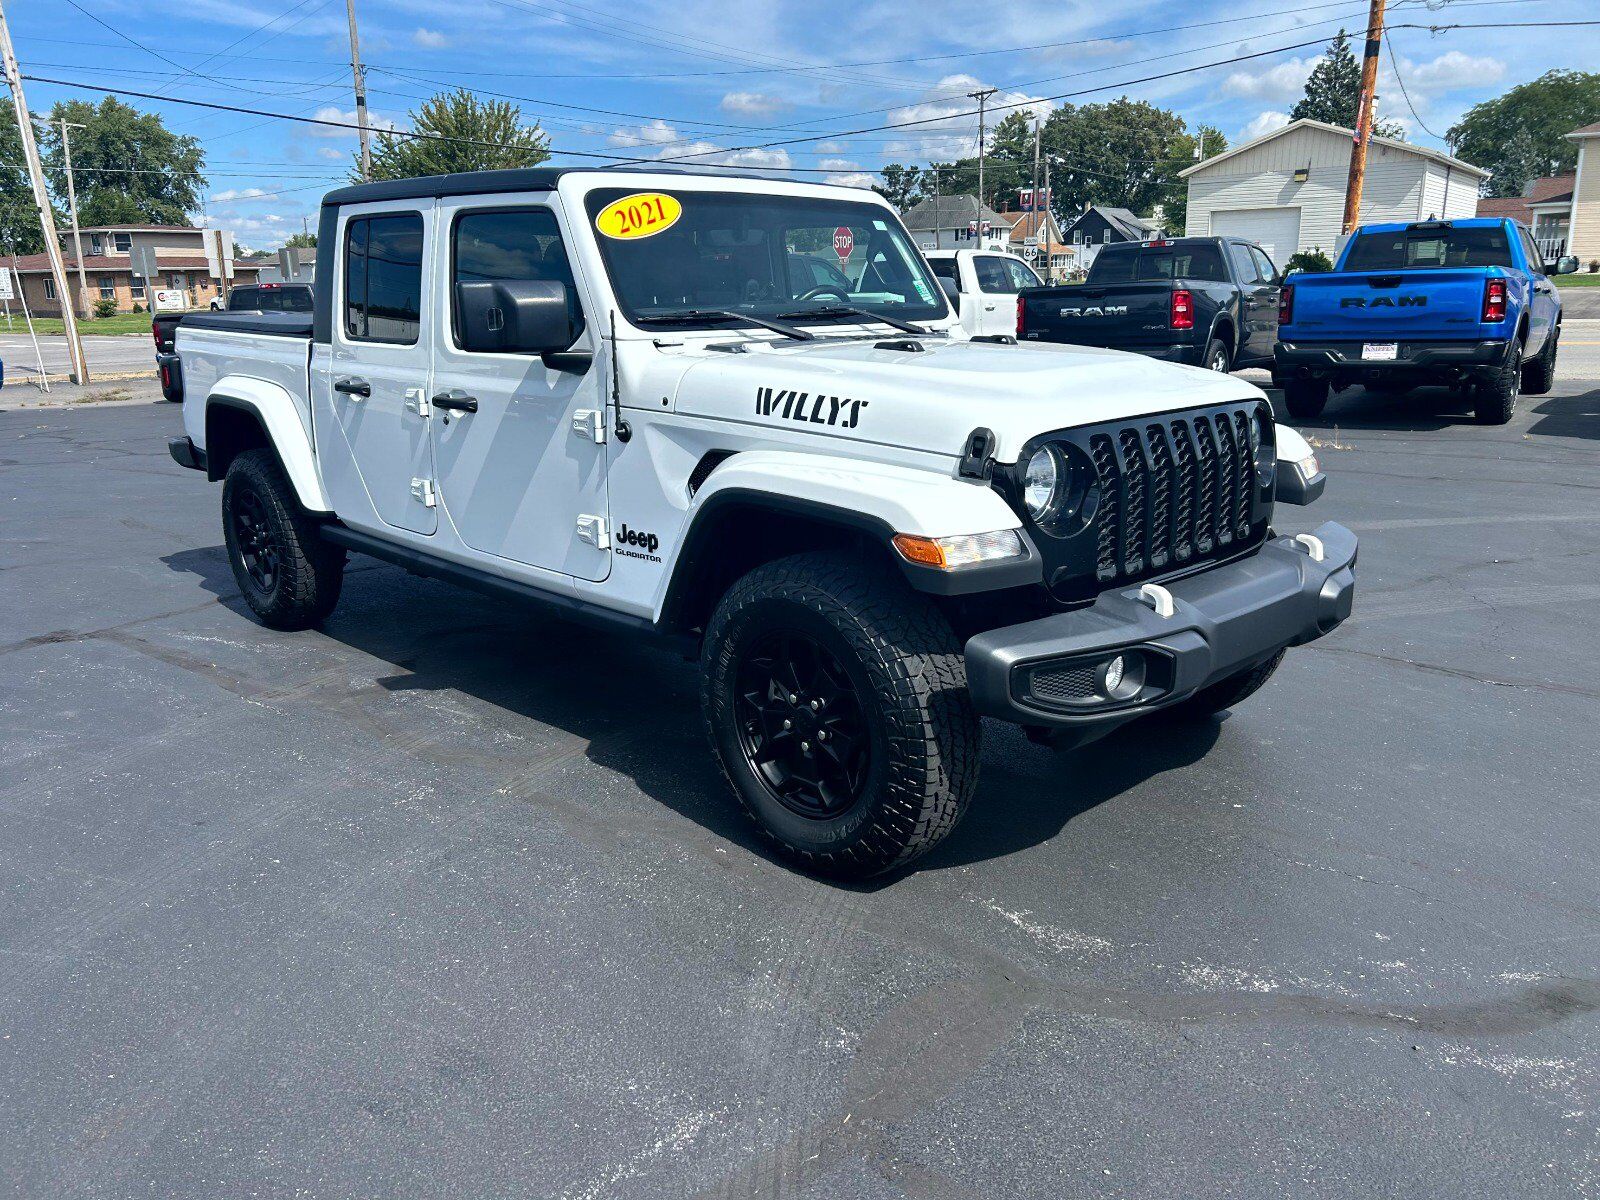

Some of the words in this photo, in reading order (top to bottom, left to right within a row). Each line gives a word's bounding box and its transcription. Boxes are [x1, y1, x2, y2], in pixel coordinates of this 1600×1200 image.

[614, 197, 667, 234] 2021
[834, 235, 852, 249] STOP
[1024, 248, 1037, 257] 66
[1340, 295, 1428, 309] RAM
[1060, 305, 1128, 317] RAM
[756, 386, 869, 429] WILLYS
[616, 523, 659, 553] Jeep
[615, 547, 663, 564] GLADIATOR
